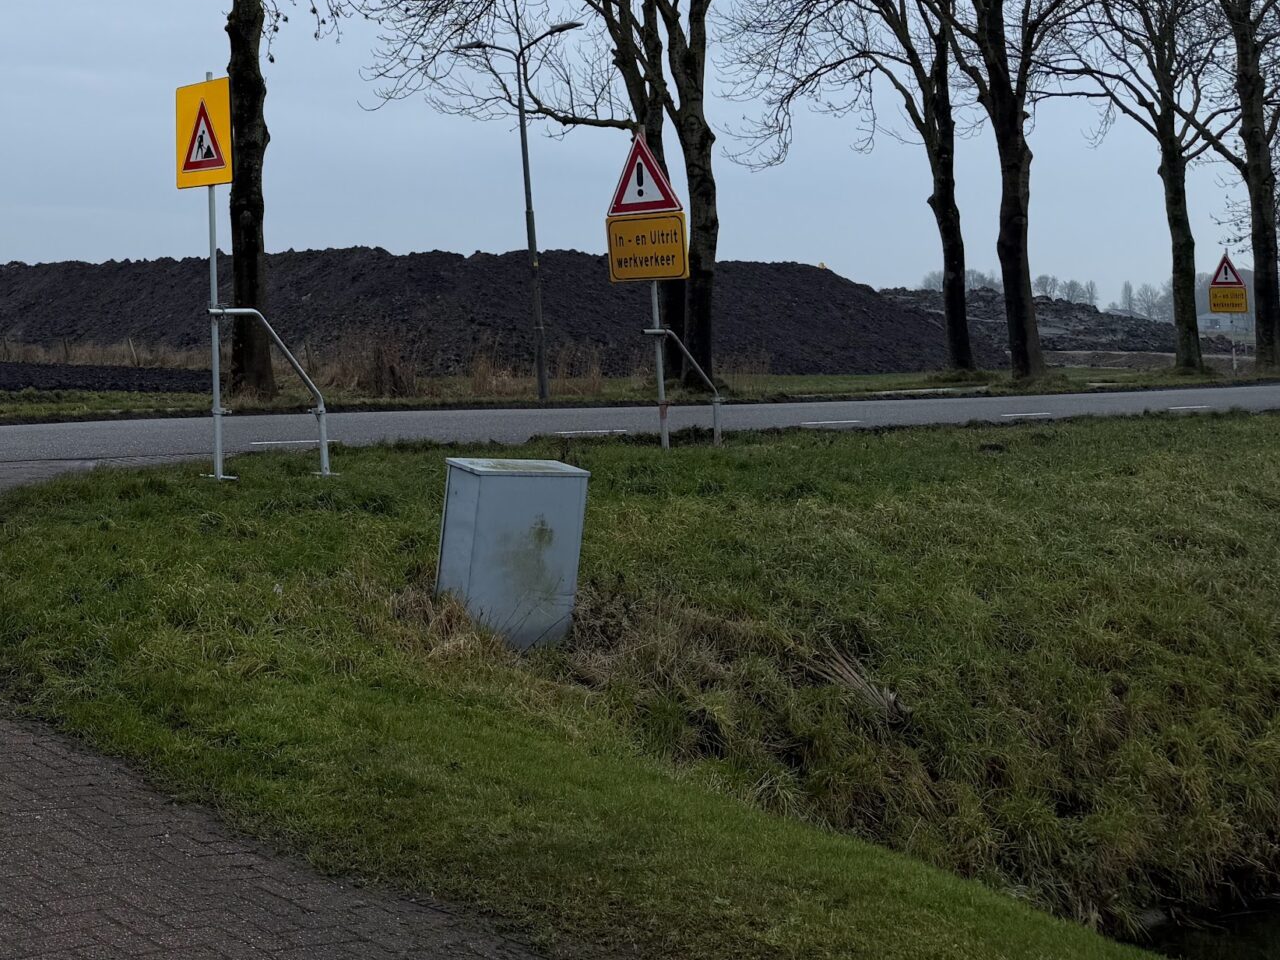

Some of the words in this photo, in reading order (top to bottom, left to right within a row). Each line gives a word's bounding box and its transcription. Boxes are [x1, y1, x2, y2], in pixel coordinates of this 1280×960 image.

[615, 233, 624, 247] In
[635, 234, 646, 245] en
[650, 229, 678, 245] Uitrit
[616, 252, 676, 268] werkverkeer
